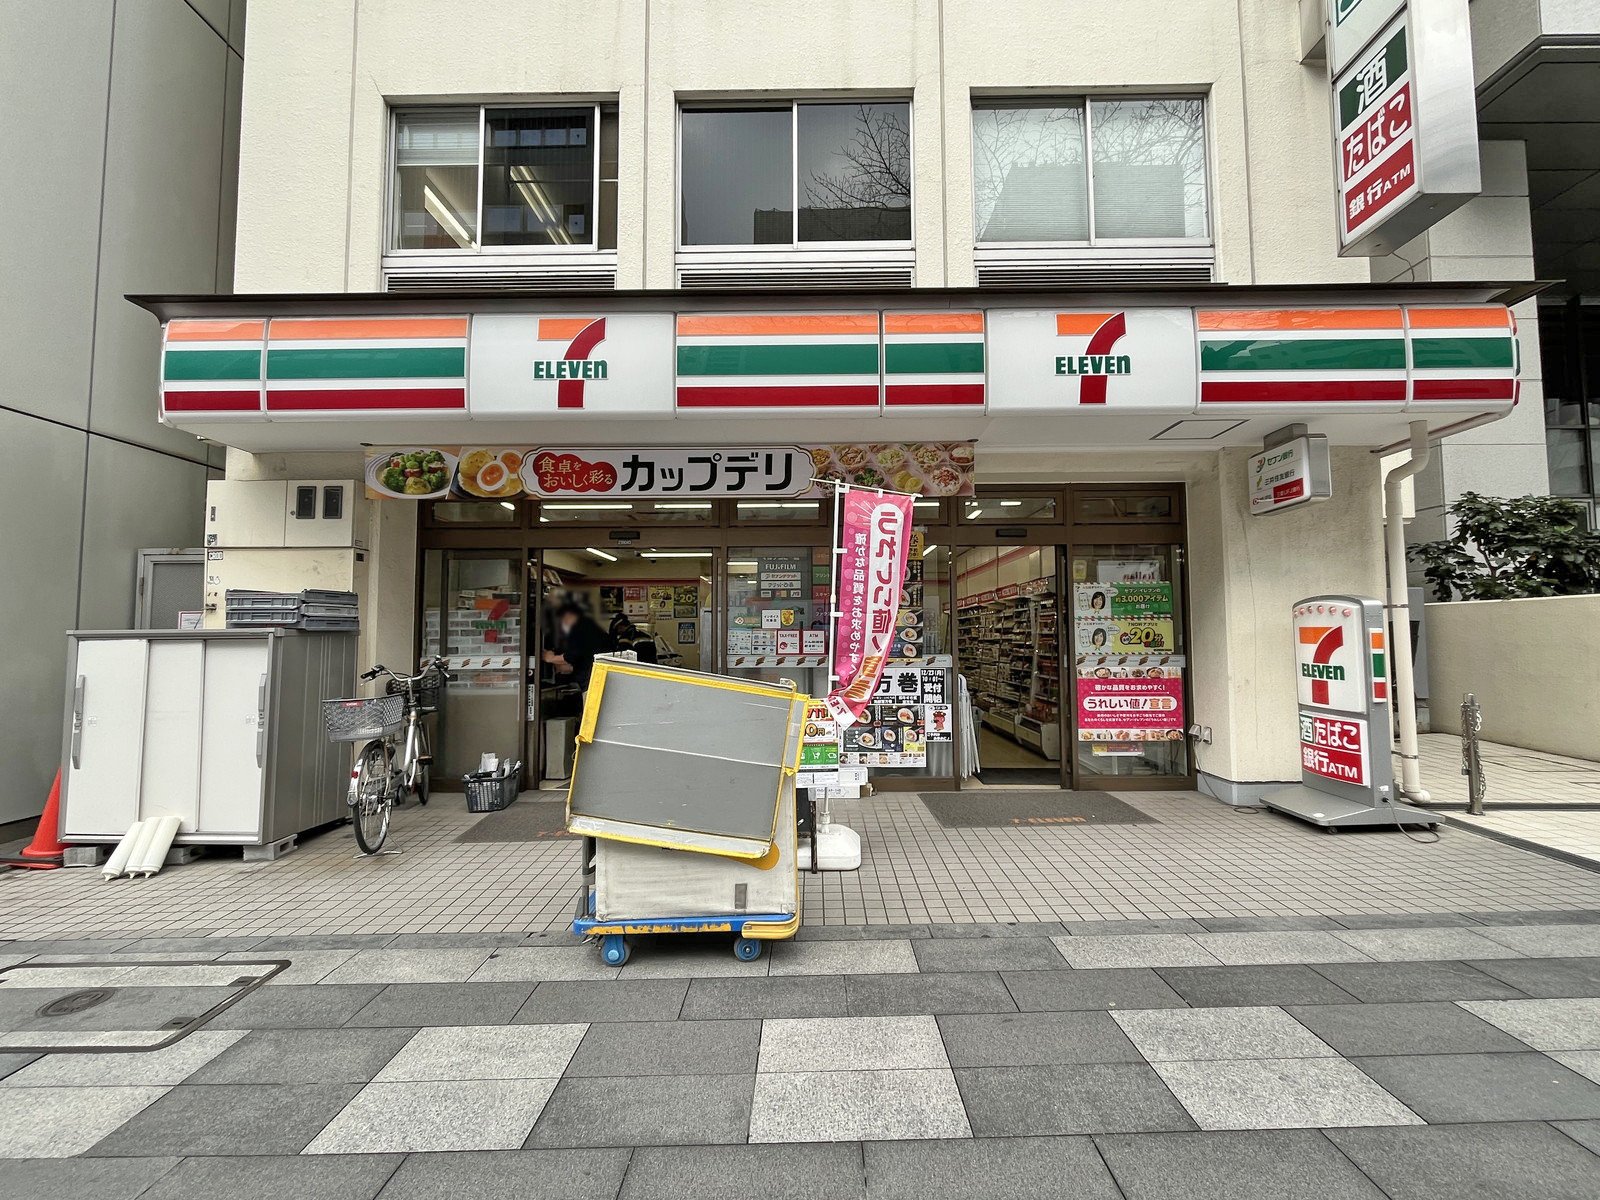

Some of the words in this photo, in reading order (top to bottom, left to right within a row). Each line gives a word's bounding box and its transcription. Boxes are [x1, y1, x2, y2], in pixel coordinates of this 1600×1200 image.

[1356, 47, 1387, 114] 酒
[1346, 93, 1408, 179] たばこ
[537, 316, 607, 409] 7
[1055, 311, 1127, 405] 7
[538, 456, 581, 473] 食卓を
[543, 469, 614, 488] おいしく彩る
[620, 452, 793, 492] カップデリ
[1298, 625, 1344, 705] 7
[1300, 716, 1313, 742] 酒
[1314, 719, 1360, 750] たばこ
